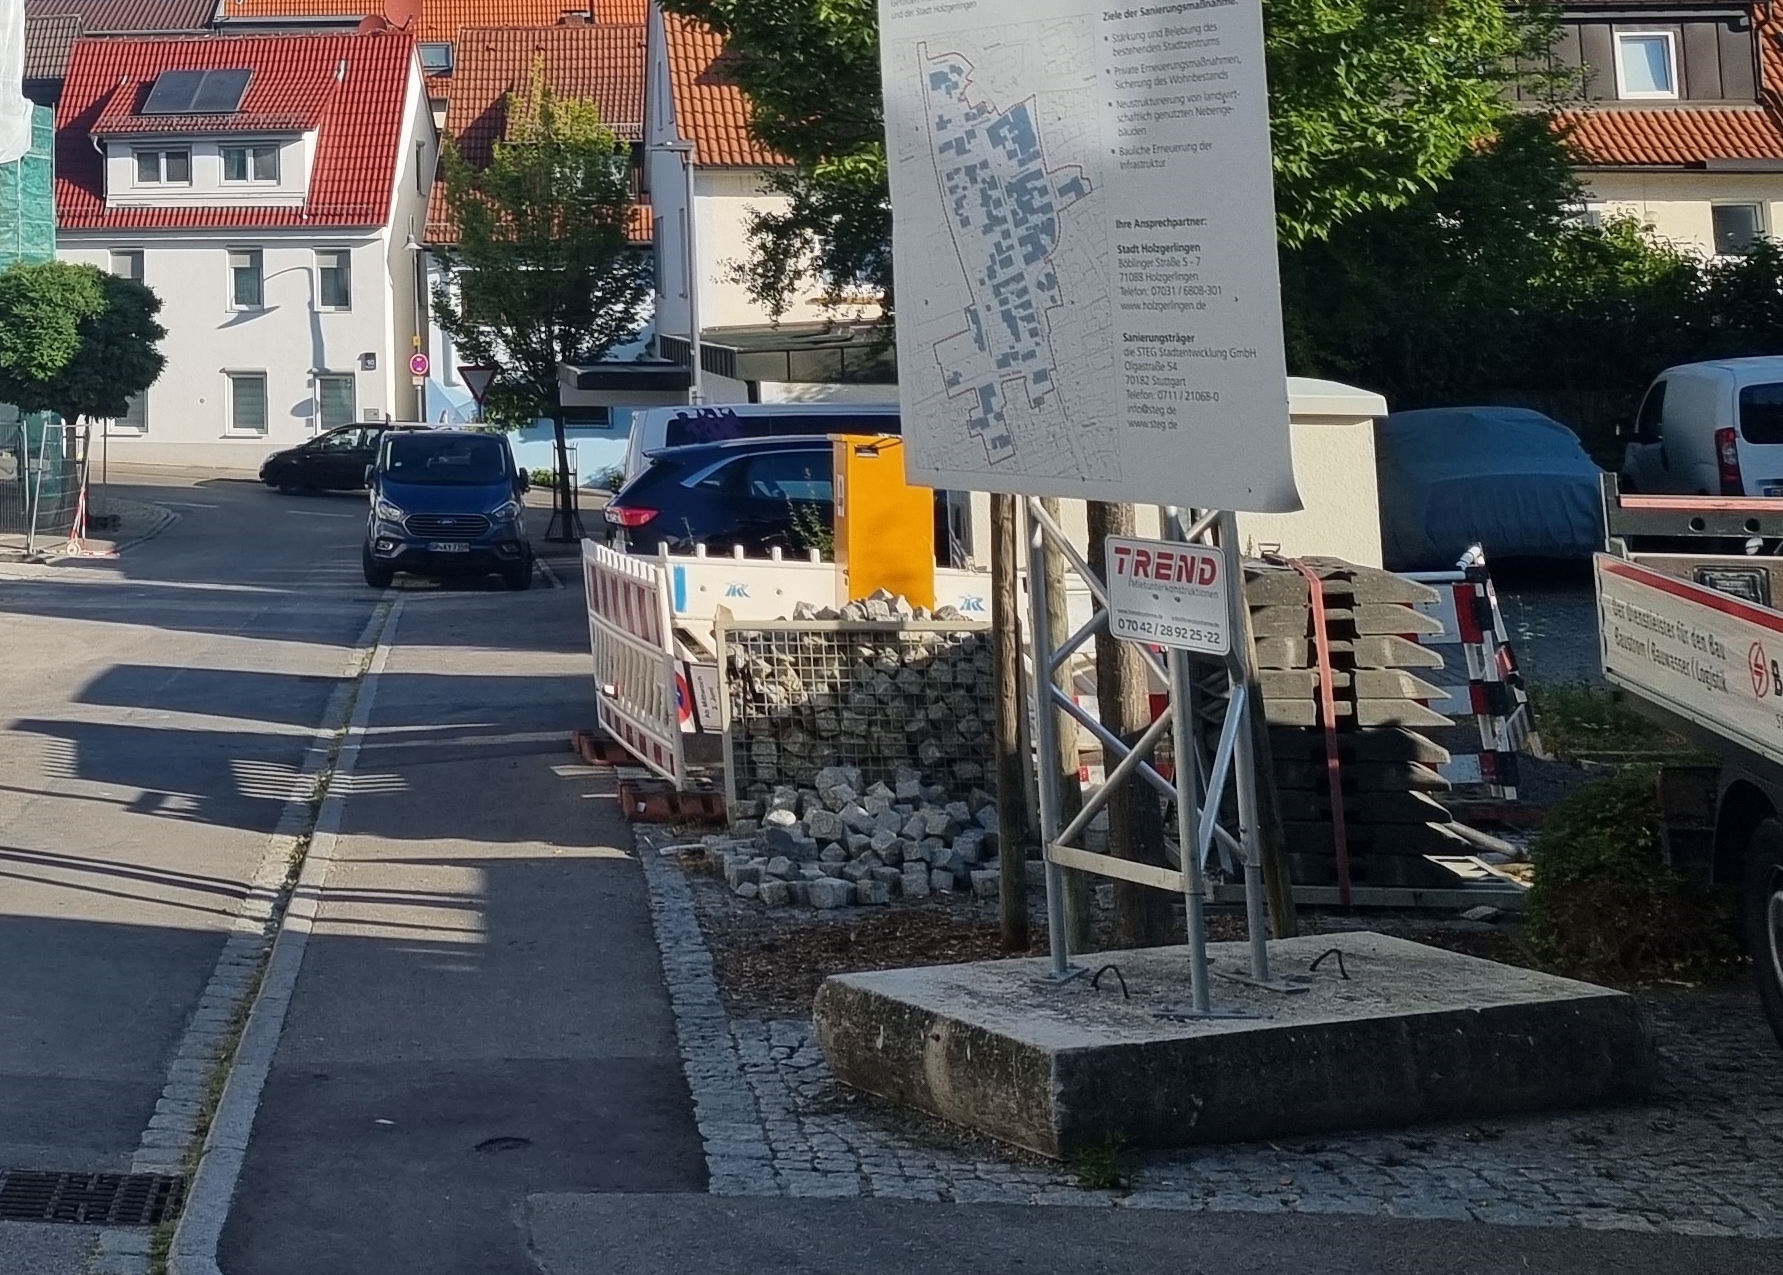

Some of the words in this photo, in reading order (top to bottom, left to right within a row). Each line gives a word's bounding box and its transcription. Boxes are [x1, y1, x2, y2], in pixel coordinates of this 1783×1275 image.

[1102, 11, 1122, 22] Ziele
[1124, 9, 1138, 19] der
[1112, 30, 1146, 43] Stärkung
[1147, 29, 1163, 39] und
[1165, 24, 1201, 37] Belebung
[1203, 23, 1218, 32] des
[1163, 38, 1220, 51] Stadtzentrums
[1115, 77, 1152, 90] Sicherung
[1154, 76, 1167, 86] des
[1169, 70, 1229, 84] Wohnbestands
[1187, 93, 1202, 102] von
[1154, 109, 1193, 122] genutzten
[1119, 145, 1151, 156] Bauliche
[1153, 142, 1197, 155] Erneuerung
[1199, 141, 1212, 151] der
[1120, 158, 1165, 170] Infrastruktur
[1116, 219, 1132, 229] Ihre
[1134, 217, 1207, 230] Ansprechpartner:
[1117, 244, 1140, 254] Stadt
[1141, 243, 1201, 255] Holzgerlingen
[1156, 256, 1181, 267] Straße
[1183, 256, 1188, 267] 5
[1196, 256, 1201, 267] 7
[1146, 271, 1199, 284] Holzgerlingen
[1120, 286, 1148, 297] Telefon:
[1151, 285, 1176, 296] 07031
[1122, 332, 1195, 345] Sanierungsträger
[1123, 347, 1136, 357] die
[1137, 347, 1157, 357] STEG
[1159, 347, 1228, 360] Stadtentwicklung
[1229, 347, 1257, 358] GmbH
[1124, 360, 1165, 373] Olgastraße
[1167, 361, 1178, 372] 54
[1152, 375, 1186, 388] Stuttgart
[1126, 389, 1154, 400] Telefon:
[1157, 390, 1177, 400] 0711
[1185, 390, 1220, 402] 21068-0
[1114, 546, 1217, 586] TREND
[1676, 620, 1689, 645] für
[1690, 626, 1707, 653] den
[1708, 633, 1727, 660] Bau
